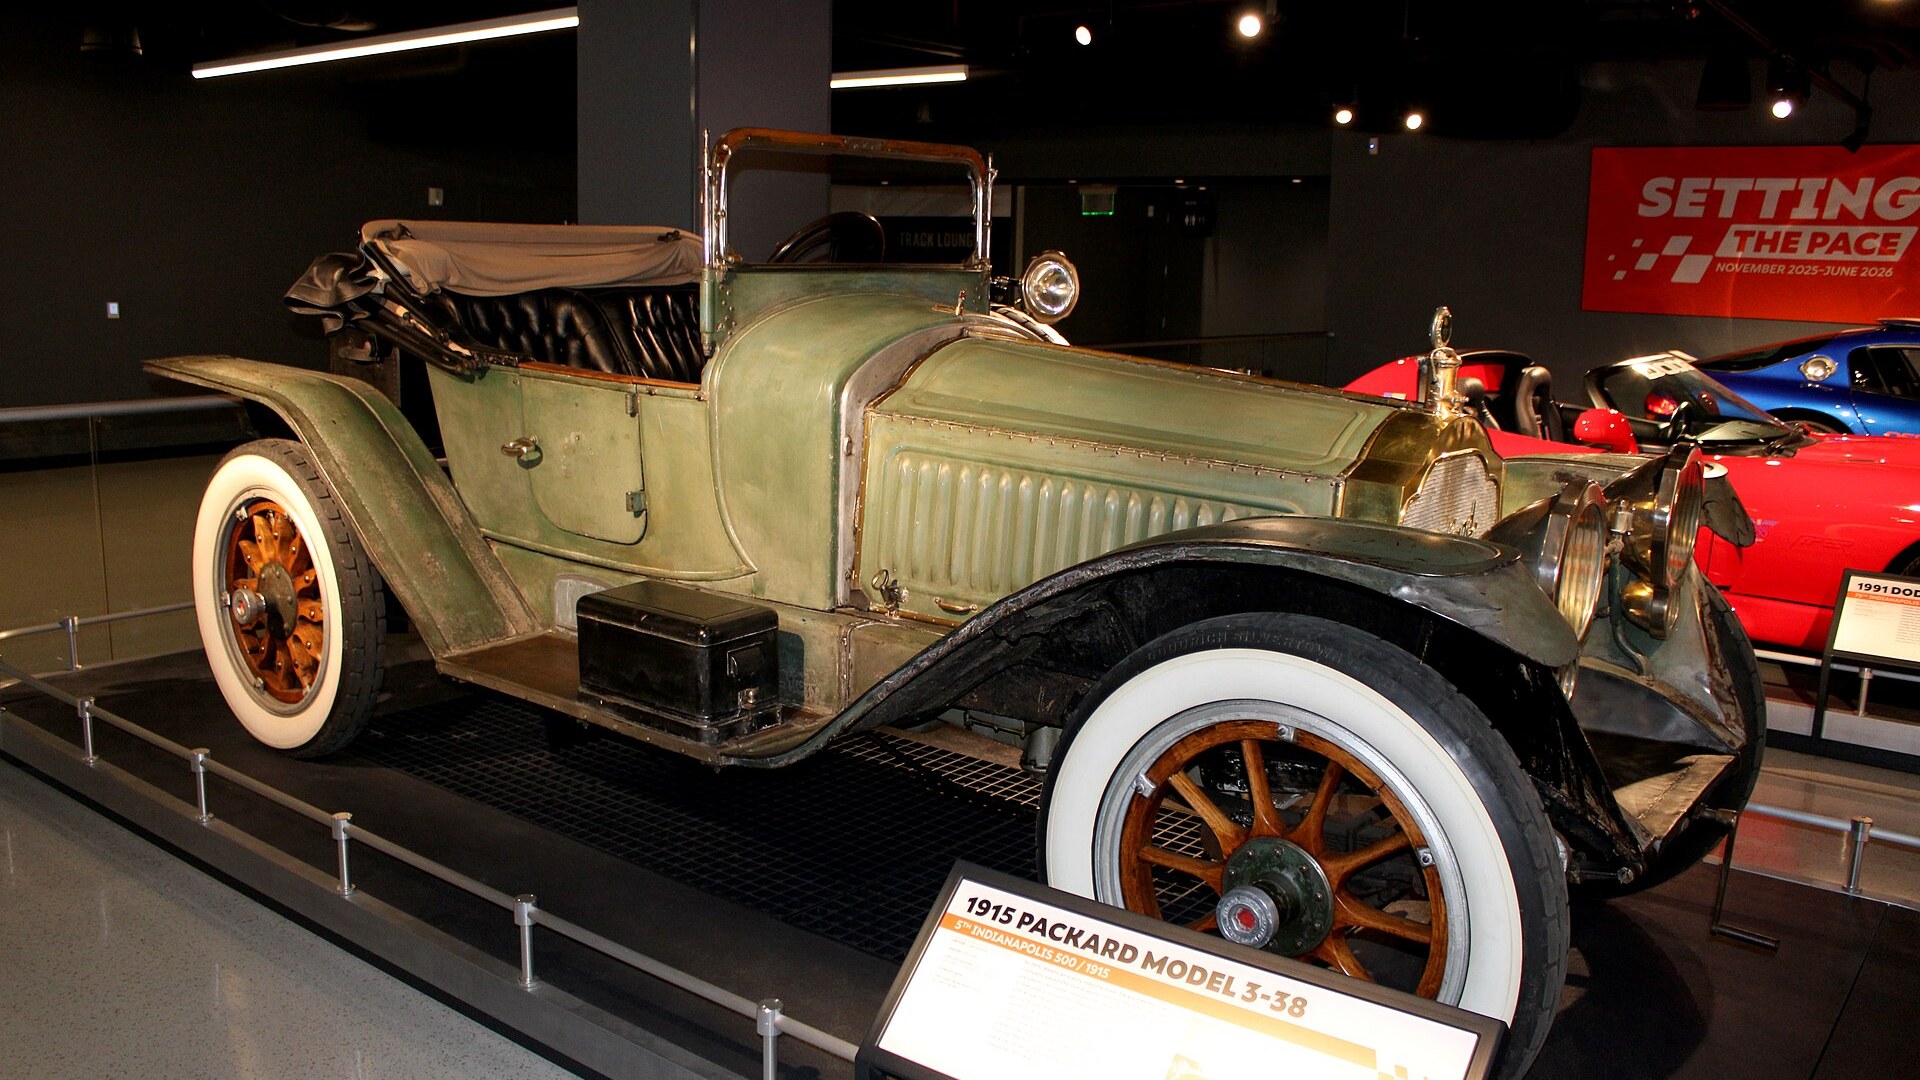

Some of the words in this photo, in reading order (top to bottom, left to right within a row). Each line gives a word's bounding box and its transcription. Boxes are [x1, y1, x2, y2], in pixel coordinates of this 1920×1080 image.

[1637, 176, 1920, 221] SETTING
[899, 231, 934, 248] TRACK
[937, 231, 974, 248] LOUNG
[1733, 230, 1805, 254] THE
[1807, 231, 1902, 256] PACE
[1715, 262, 1785, 275] NOVEMBER
[1859, 266, 1894, 278] 2026
[1857, 582, 1888, 594] 1991
[953, 919, 972, 932] 5TH
[971, 925, 1054, 961] INDIANAPOLIS
[1053, 951, 1077, 968] 500
[1076, 958, 1084, 972] /
[1085, 961, 1111, 979] 1915
[964, 896, 1016, 926] 1915
[1015, 912, 1140, 966] PACKARD
[1140, 954, 1239, 999] MODEL
[1240, 981, 1309, 1019] 3-38
